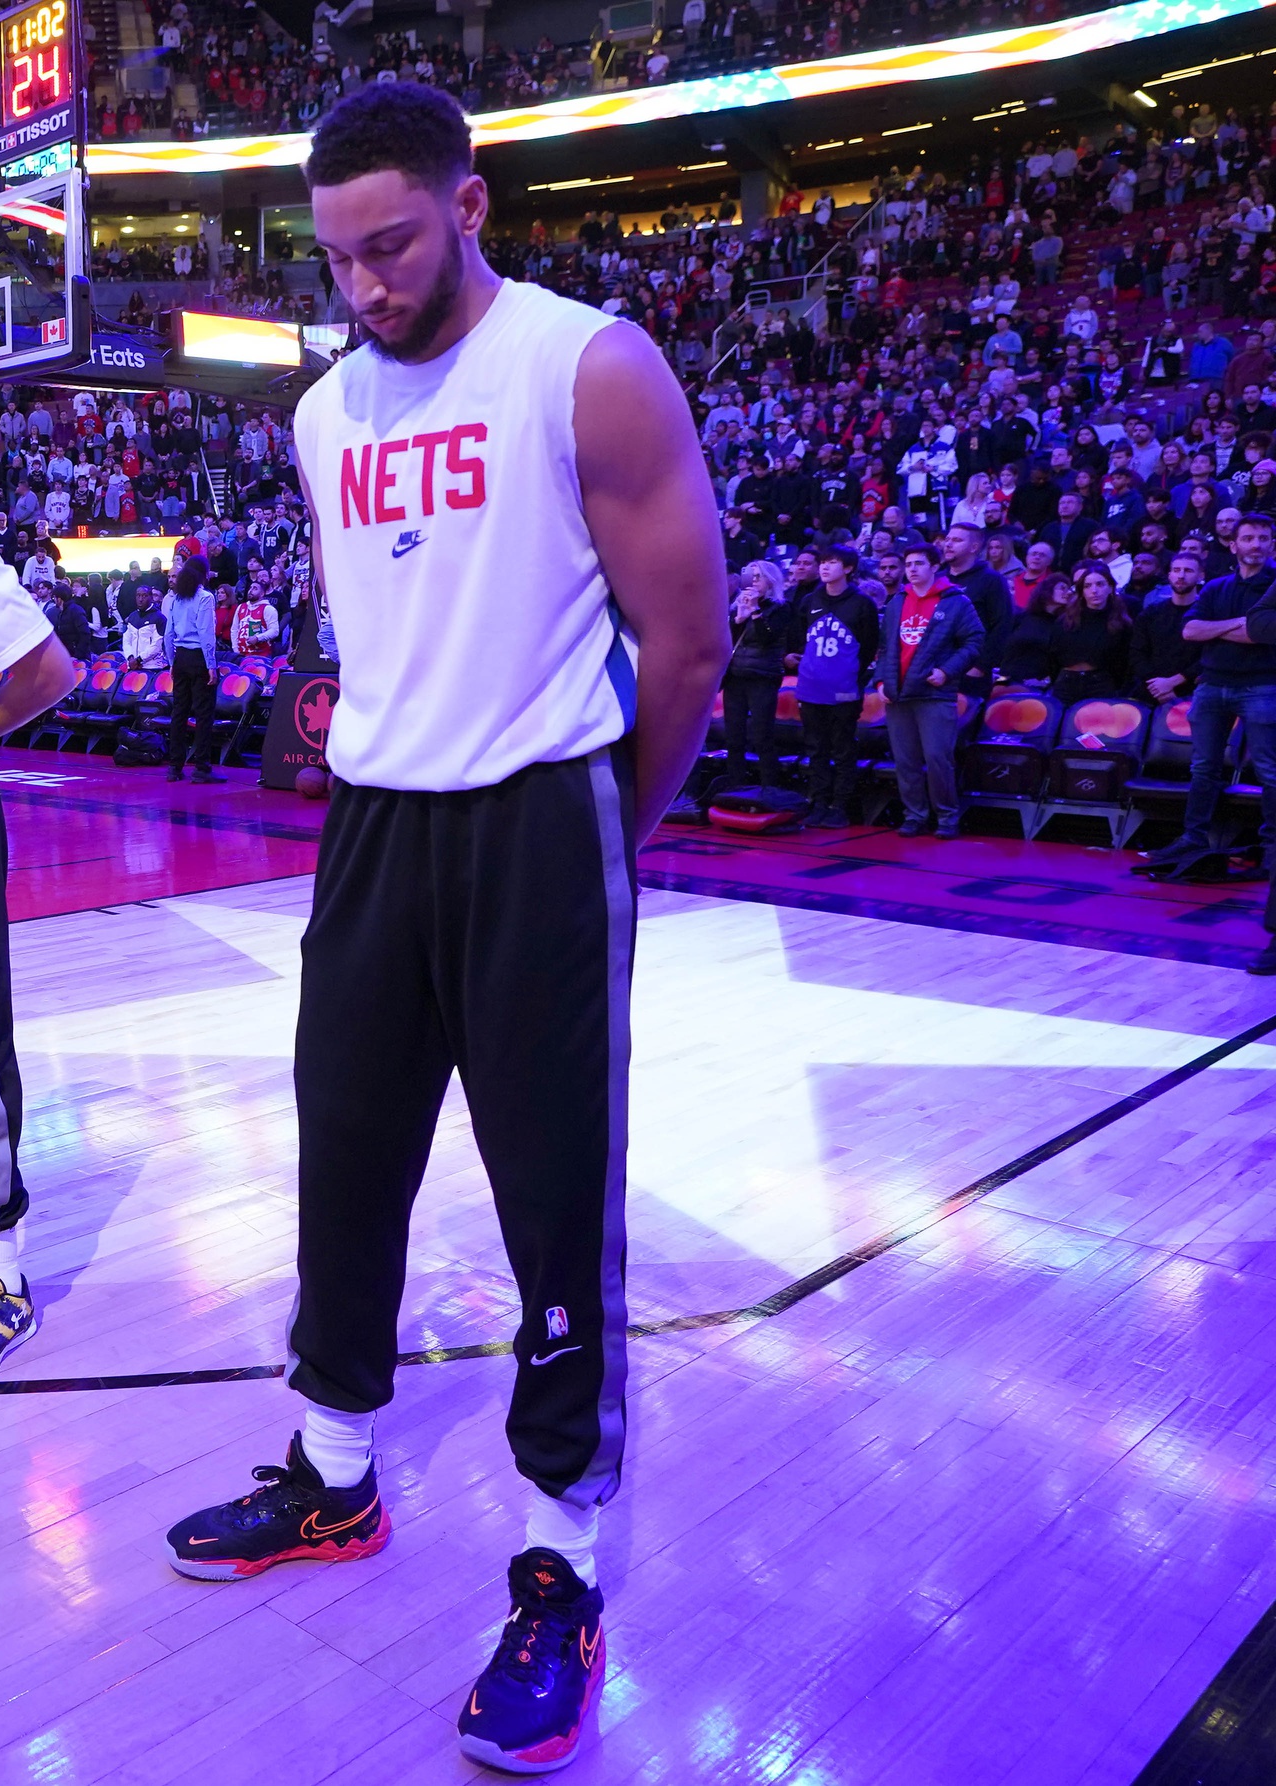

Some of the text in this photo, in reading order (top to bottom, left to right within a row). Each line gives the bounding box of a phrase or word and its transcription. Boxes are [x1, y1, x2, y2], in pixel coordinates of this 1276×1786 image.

[12, 1, 65, 54] 11:02
[12, 46, 60, 117] 24
[17, 109, 70, 144] TISSOT
[101, 345, 146, 368] Eats
[341, 422, 488, 529] NETS
[828, 488, 835, 501] 7
[265, 537, 277, 547] 35
[815, 637, 839, 657] 18
[283, 753, 304, 763] AIR
